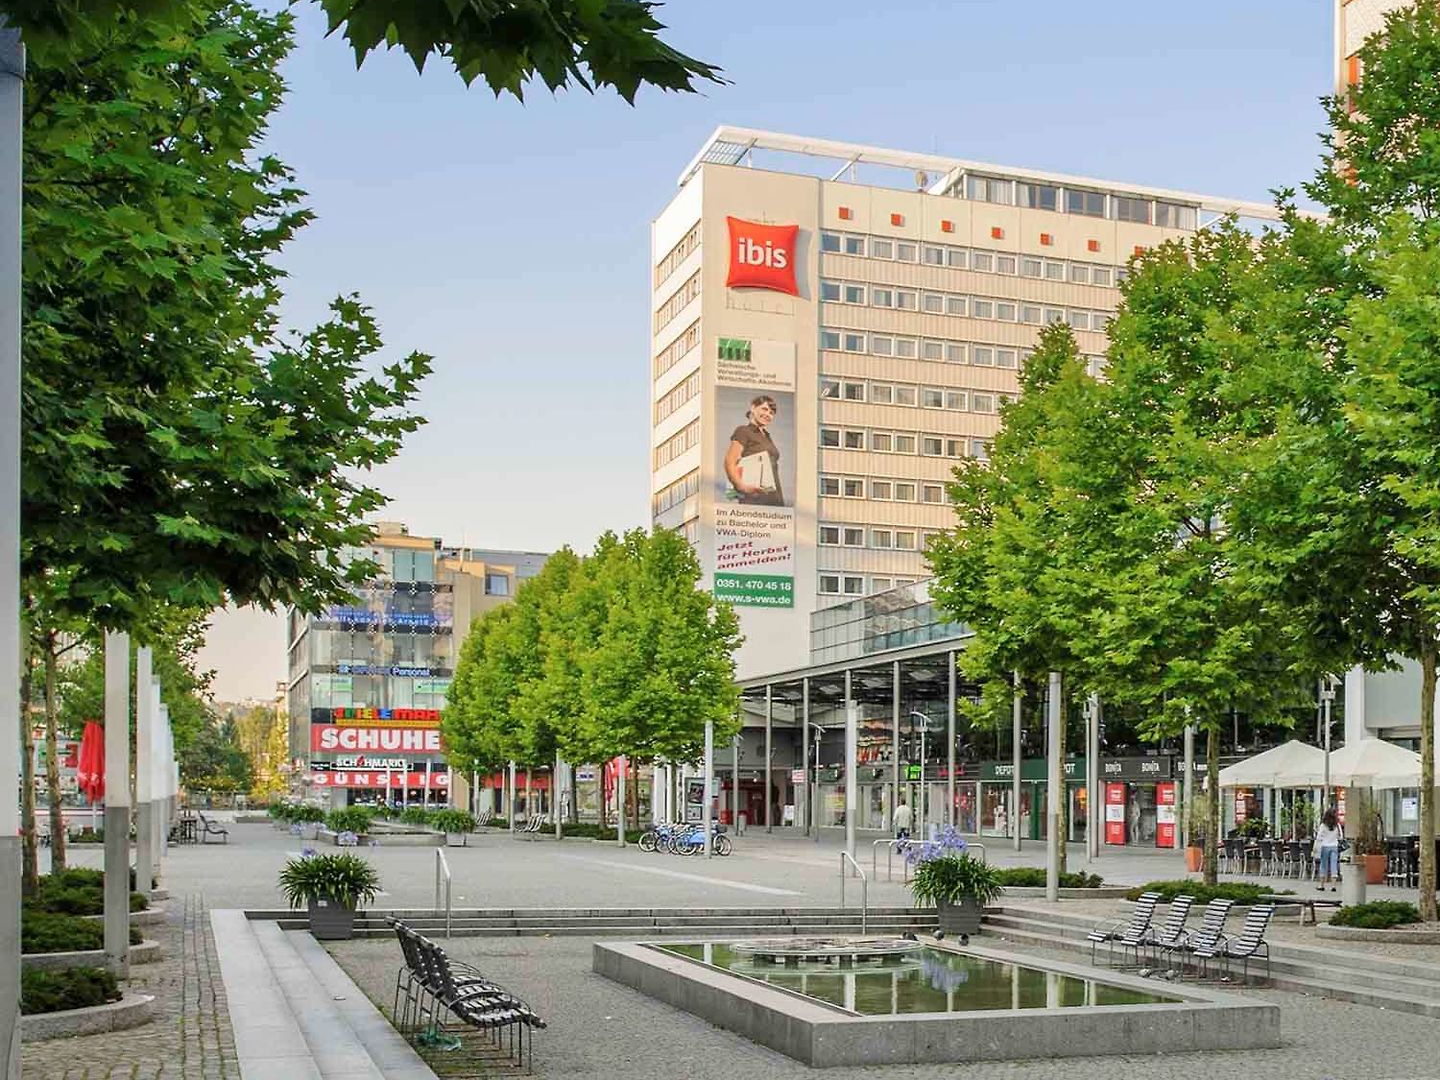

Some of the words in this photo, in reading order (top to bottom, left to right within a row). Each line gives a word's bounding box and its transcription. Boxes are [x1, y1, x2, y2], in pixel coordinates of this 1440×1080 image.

[738, 237, 787, 269] ibis
[730, 509, 792, 520] Abendstudium
[729, 519, 768, 528] Bachelor
[717, 541, 753, 551] Jetzt
[717, 553, 738, 561] für
[742, 546, 788, 558] Herbst
[717, 552, 791, 569] anmelden!
[745, 580, 763, 589] 470
[765, 581, 778, 590] 45
[780, 582, 792, 591] 18
[320, 727, 440, 750] SCHUHE
